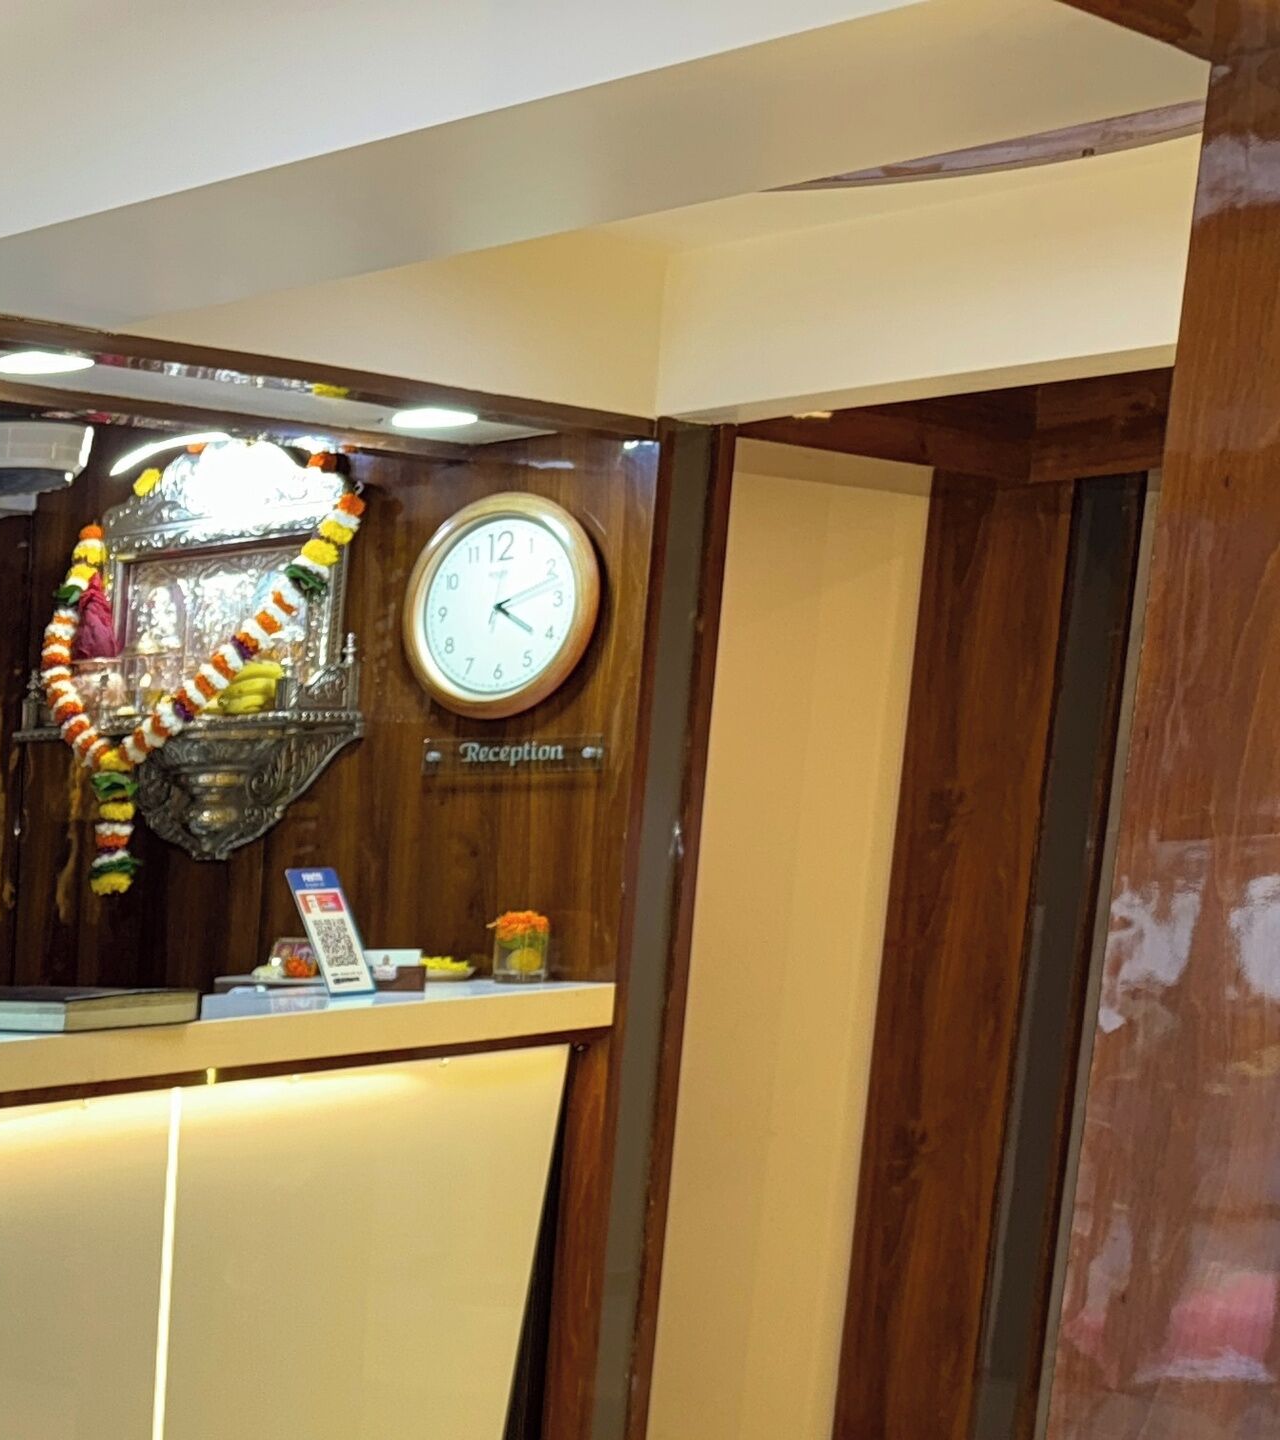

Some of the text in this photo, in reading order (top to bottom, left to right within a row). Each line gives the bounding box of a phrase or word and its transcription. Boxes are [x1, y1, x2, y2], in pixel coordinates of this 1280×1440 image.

[489, 531, 514, 563] 12
[529, 539, 534, 552] 1
[469, 547, 479, 563] 11
[546, 559, 558, 578] 2
[446, 574, 458, 590] 10
[554, 592, 563, 607] 3
[438, 607, 447, 622] 9
[546, 625, 554, 639] 4
[445, 638, 454, 653] 8
[466, 658, 475, 674] 7
[523, 652, 532, 668] 5
[494, 664, 502, 679] 6
[459, 743, 564, 766] Reception
